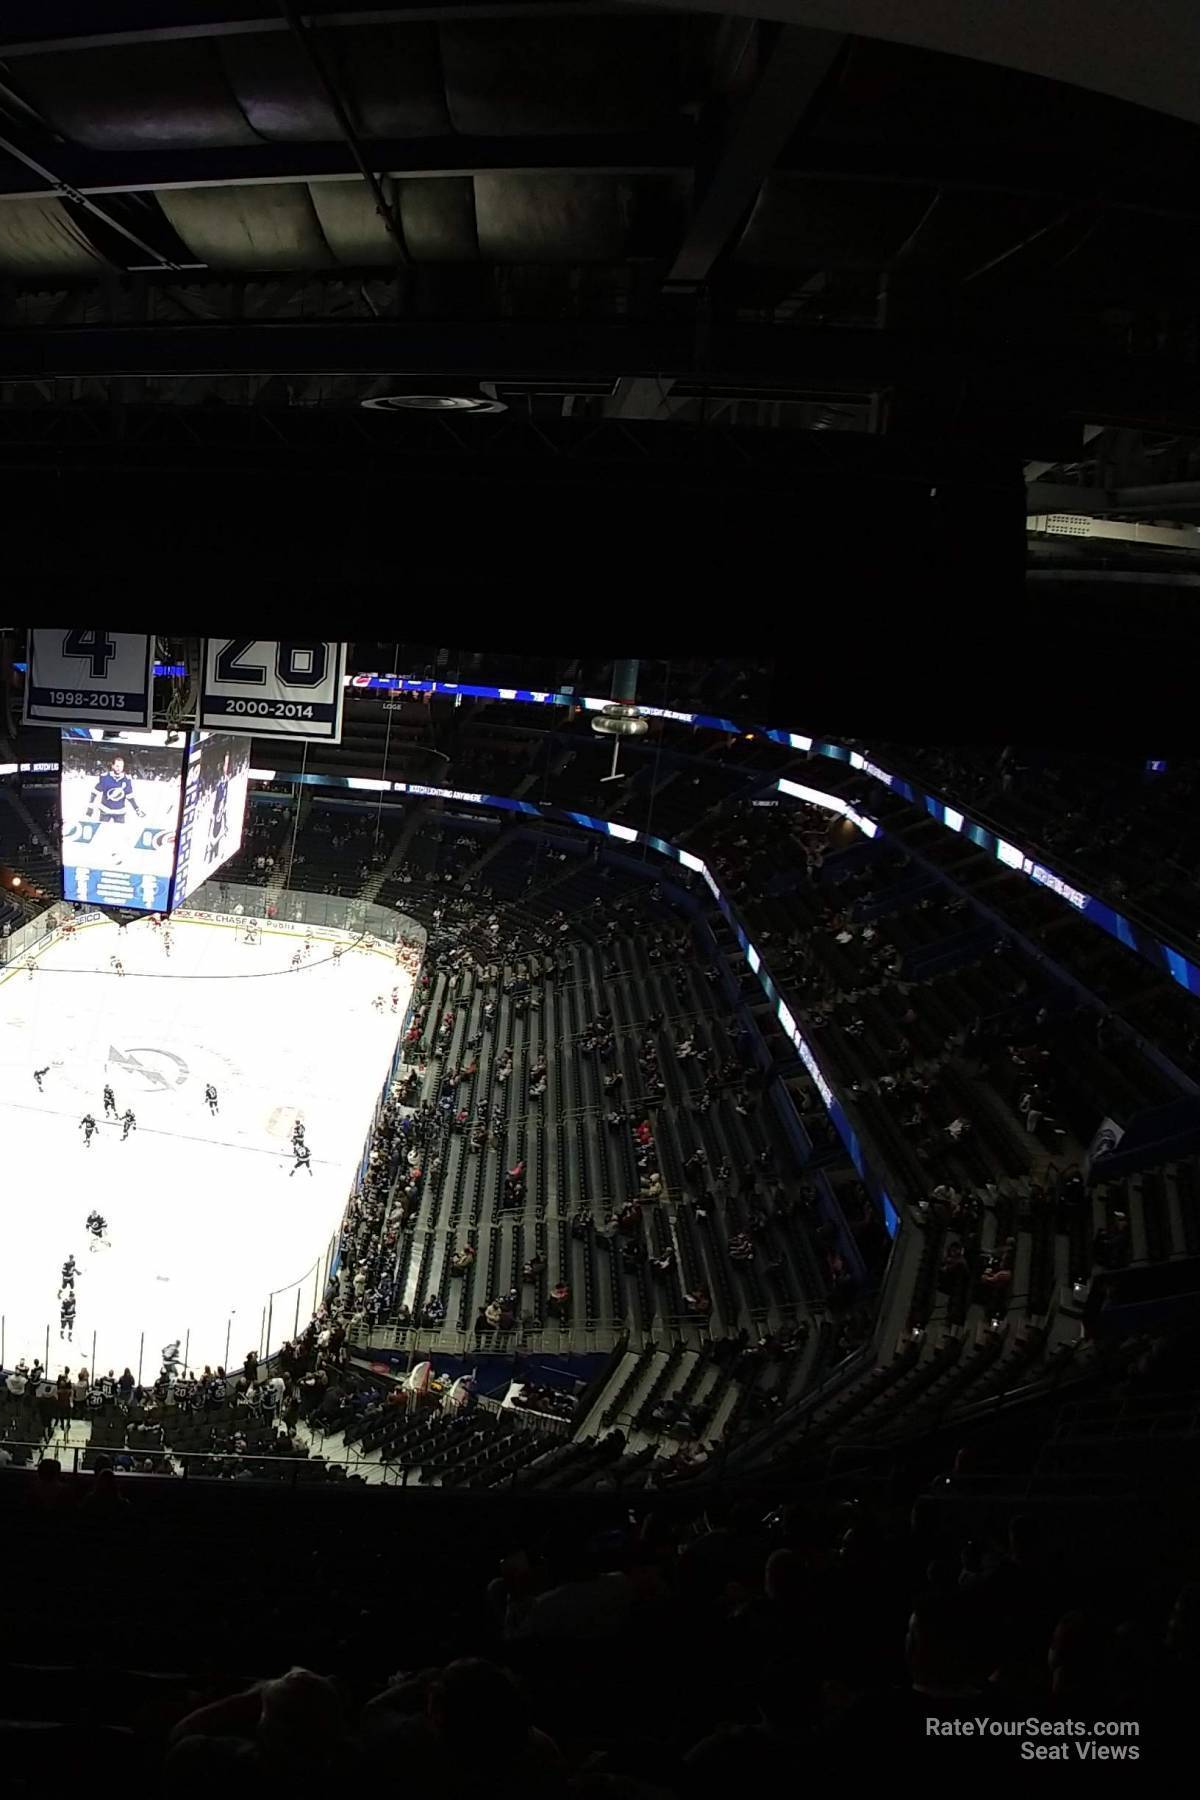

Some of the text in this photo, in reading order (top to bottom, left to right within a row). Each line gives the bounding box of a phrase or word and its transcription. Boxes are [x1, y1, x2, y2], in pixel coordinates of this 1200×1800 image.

[62, 629, 116, 679] 4
[49, 691, 125, 708] 1998-2013
[226, 700, 313, 718] 2000-2014
[216, 914, 247, 925] CHASE
